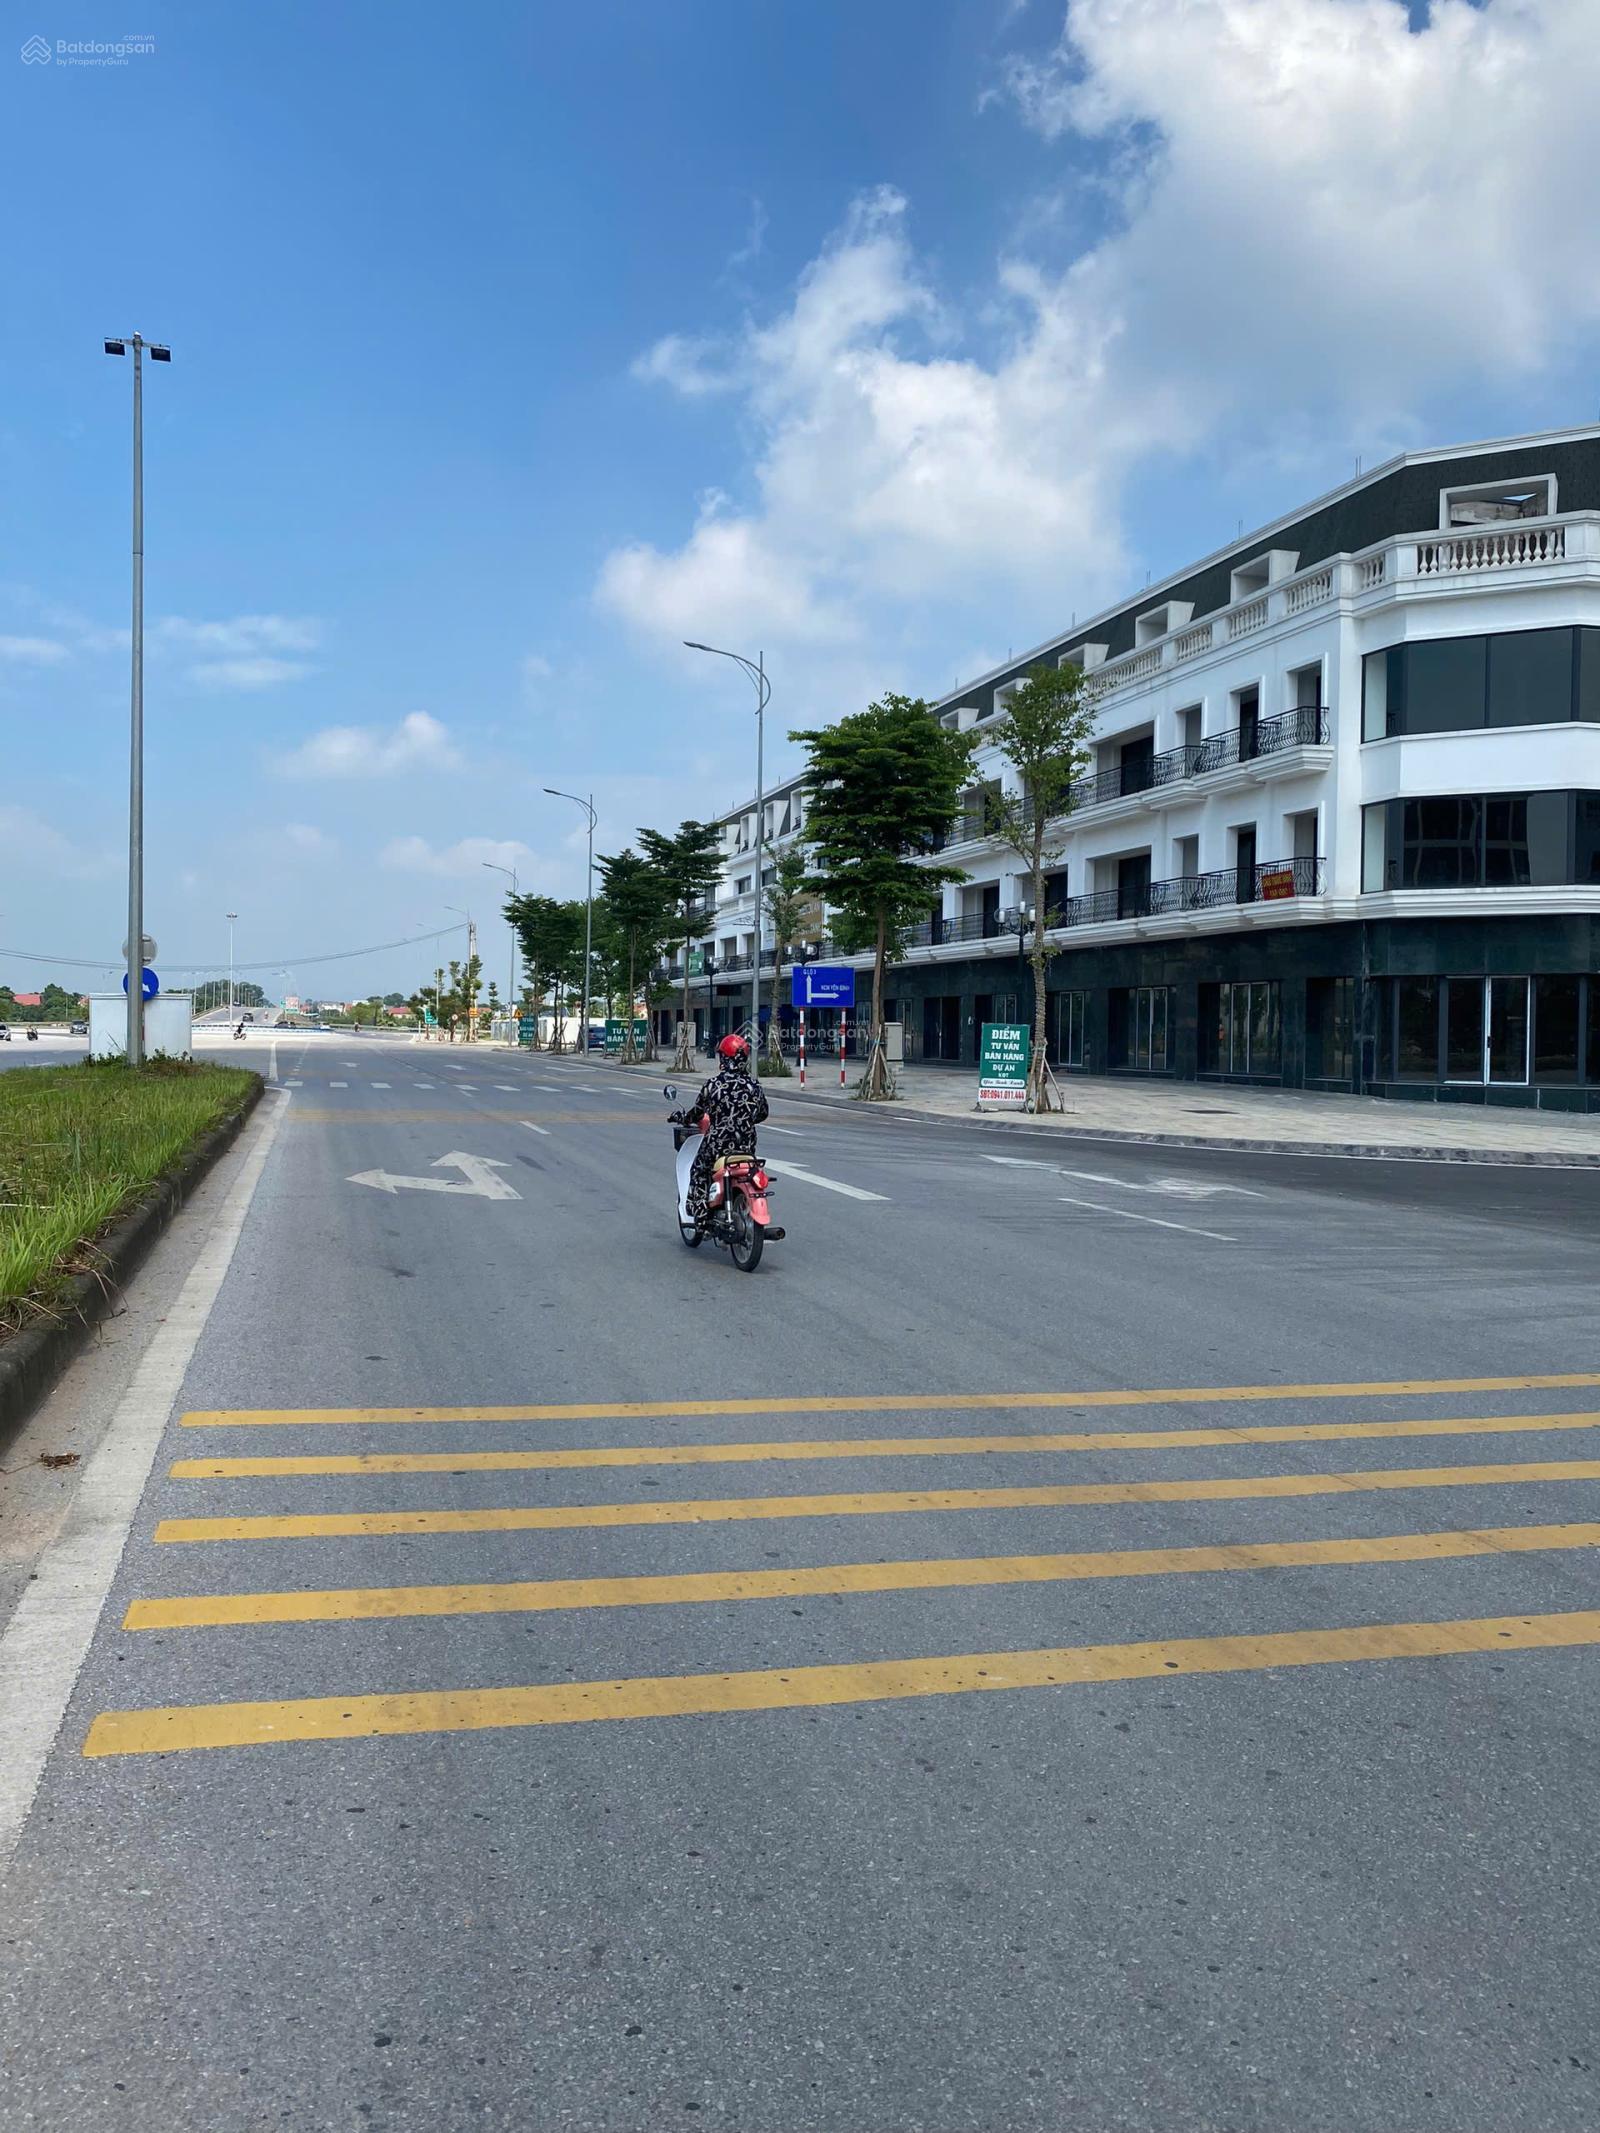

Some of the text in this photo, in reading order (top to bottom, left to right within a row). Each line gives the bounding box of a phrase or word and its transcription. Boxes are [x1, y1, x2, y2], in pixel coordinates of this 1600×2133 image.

[607, 1034, 624, 1042] BÁN
[991, 1026, 1020, 1041] ĐIỂM
[991, 1041, 1020, 1051] TƯ VẤN
[984, 1051, 1024, 1061] BÁN HÀNG
